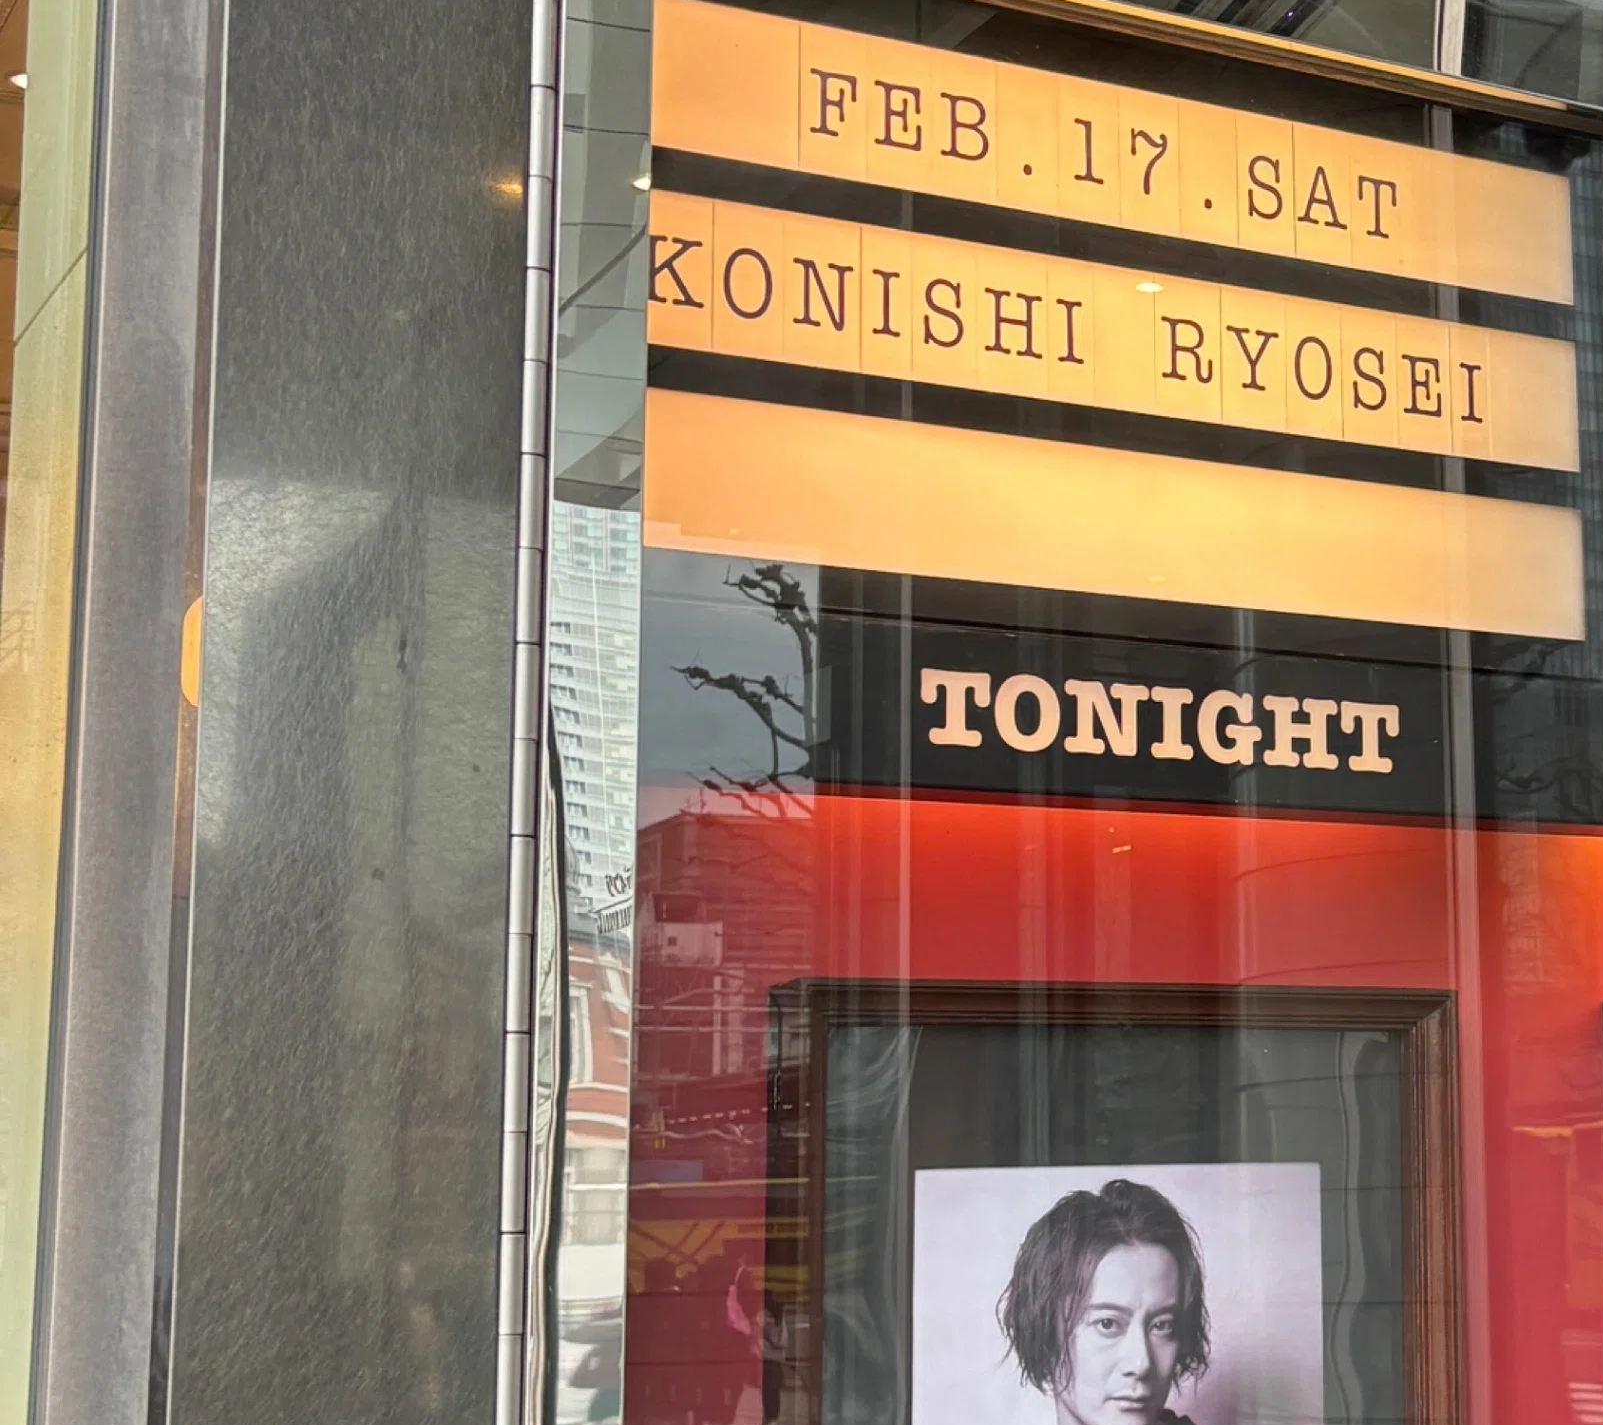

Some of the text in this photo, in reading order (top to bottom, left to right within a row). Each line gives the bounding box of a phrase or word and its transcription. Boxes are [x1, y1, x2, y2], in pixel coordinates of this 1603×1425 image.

[808, 66, 1400, 241] FEB.17.SAT
[648, 234, 1485, 425] KONISHI RYOSEI
[920, 667, 1401, 775] TONIGHT
